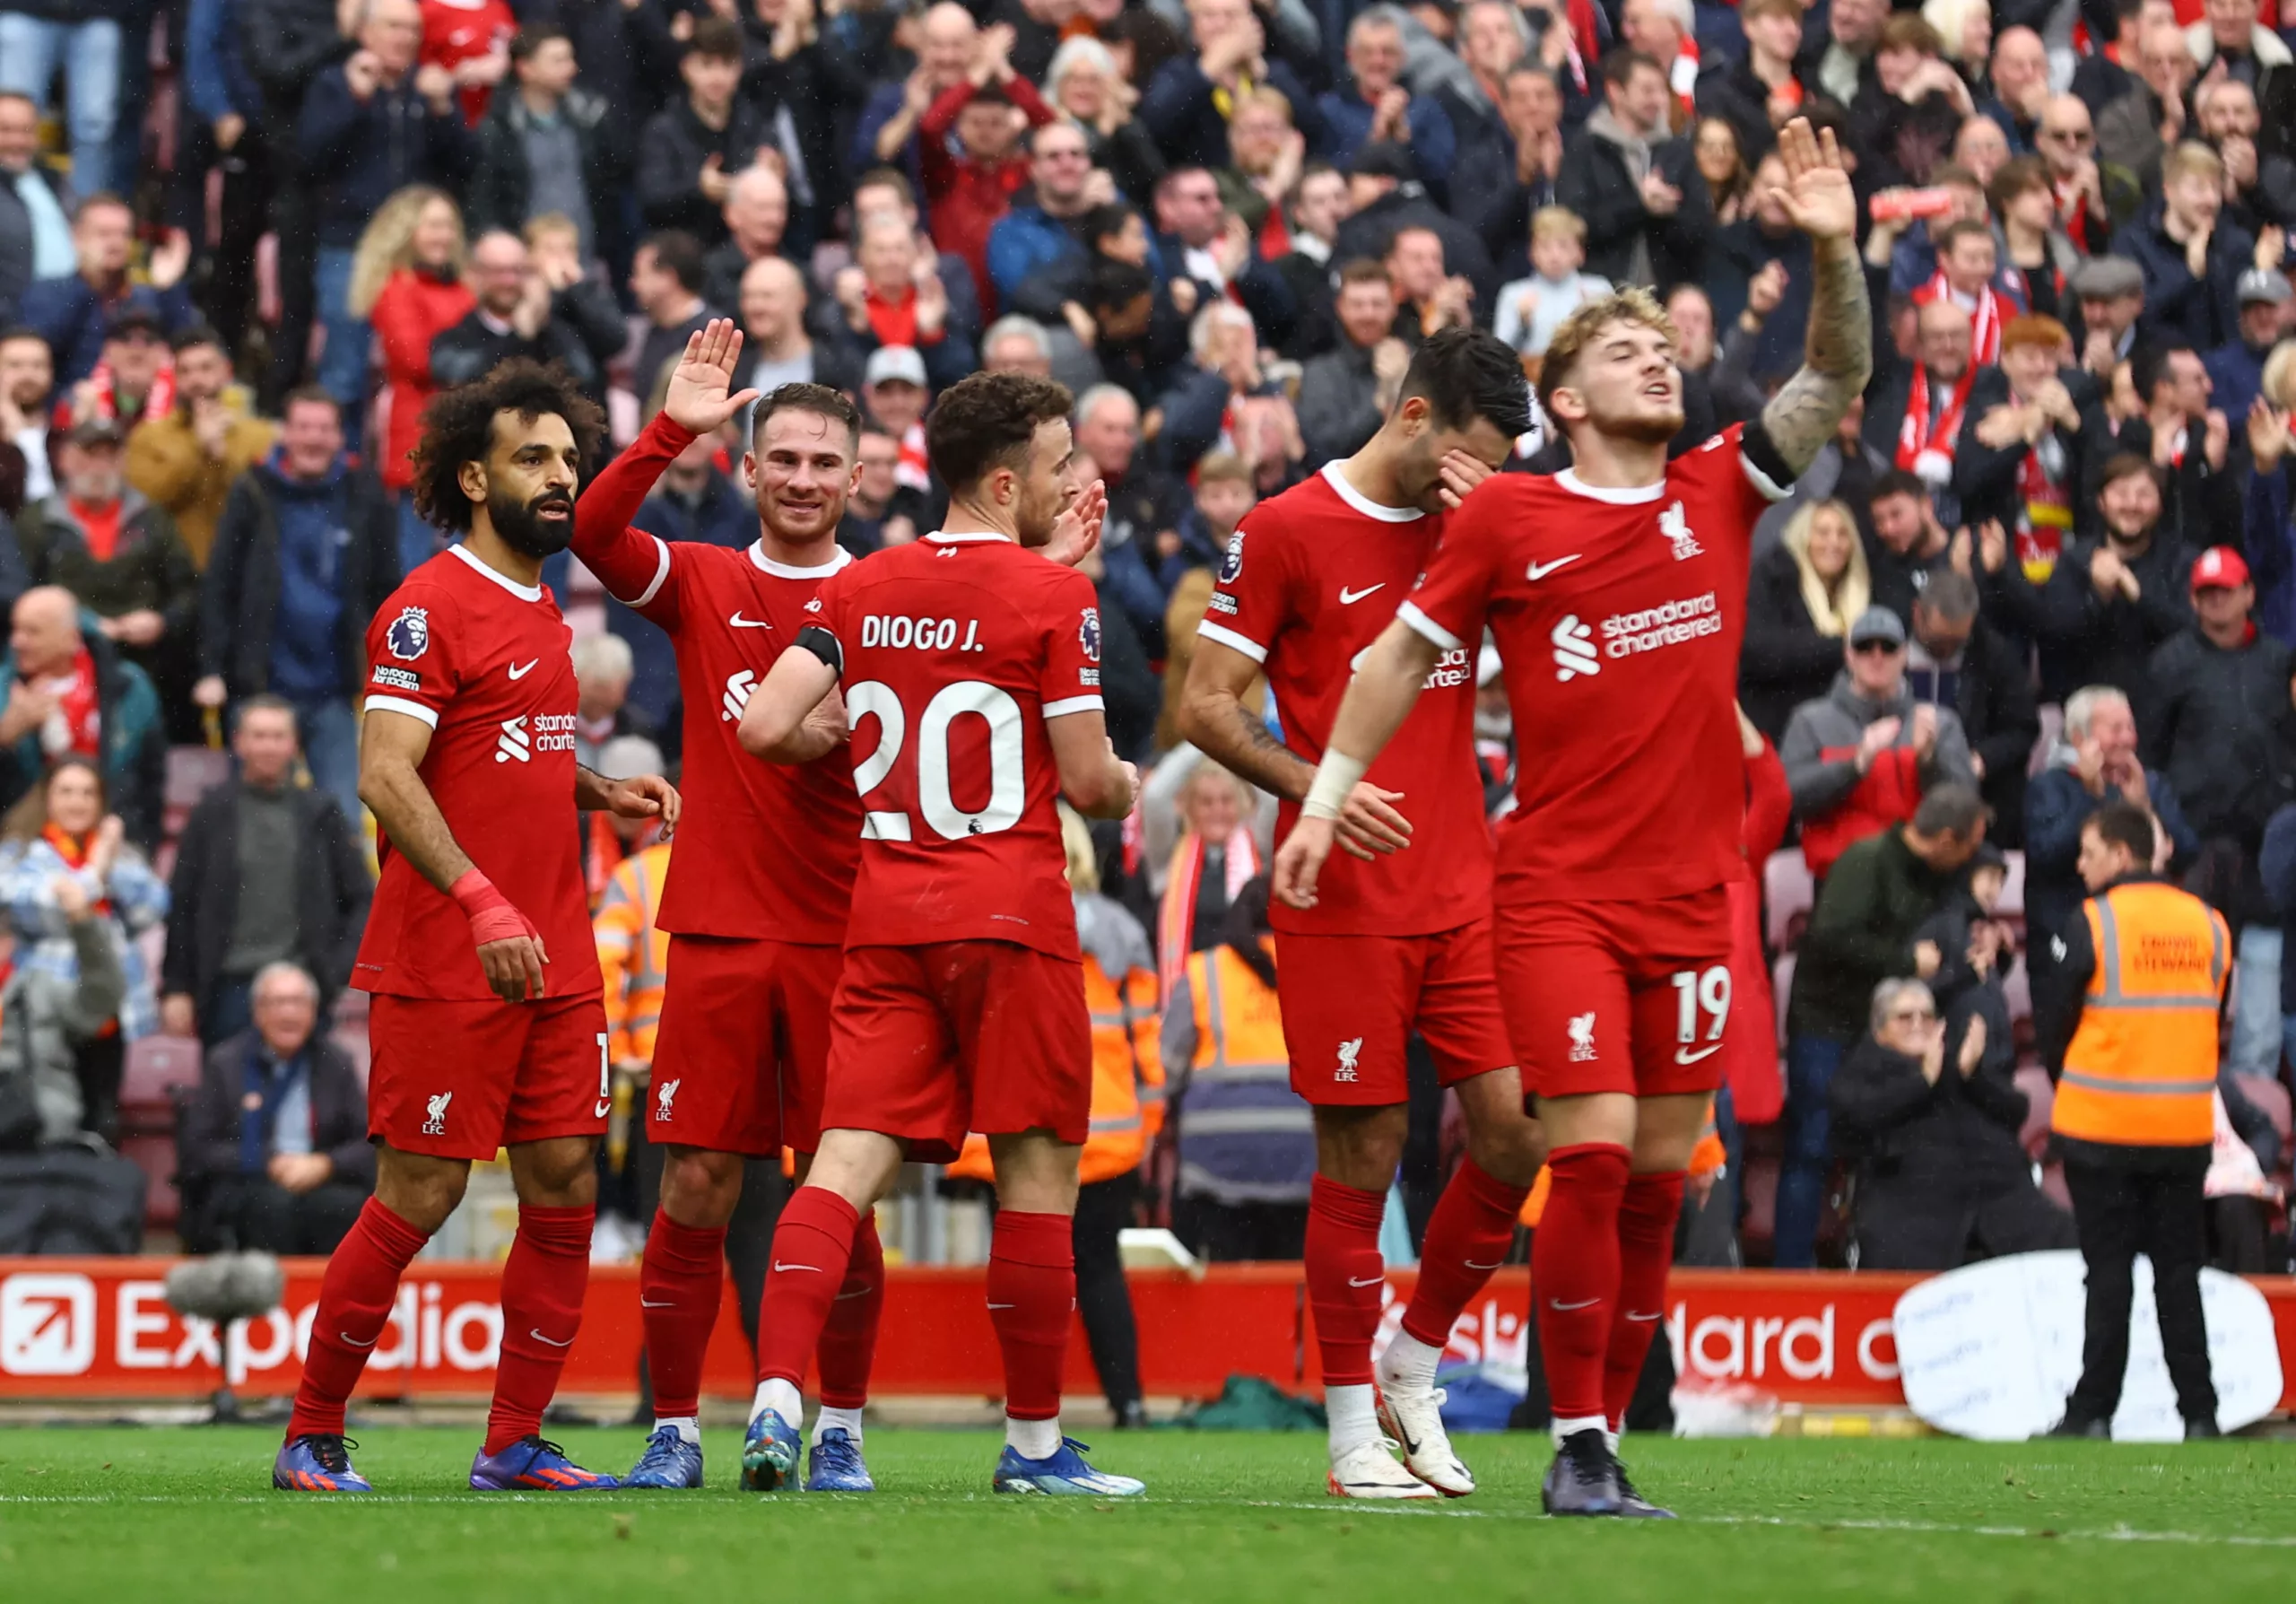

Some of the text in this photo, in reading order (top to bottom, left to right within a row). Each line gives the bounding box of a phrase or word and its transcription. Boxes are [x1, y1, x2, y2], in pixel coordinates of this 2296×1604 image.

[862, 615, 985, 652] DIOGO J.
[1599, 590, 1716, 639] standard
[1605, 610, 1722, 658] chartered
[389, 667, 417, 682] room
[846, 680, 1025, 841] 20
[1671, 965, 1732, 1043] 19
